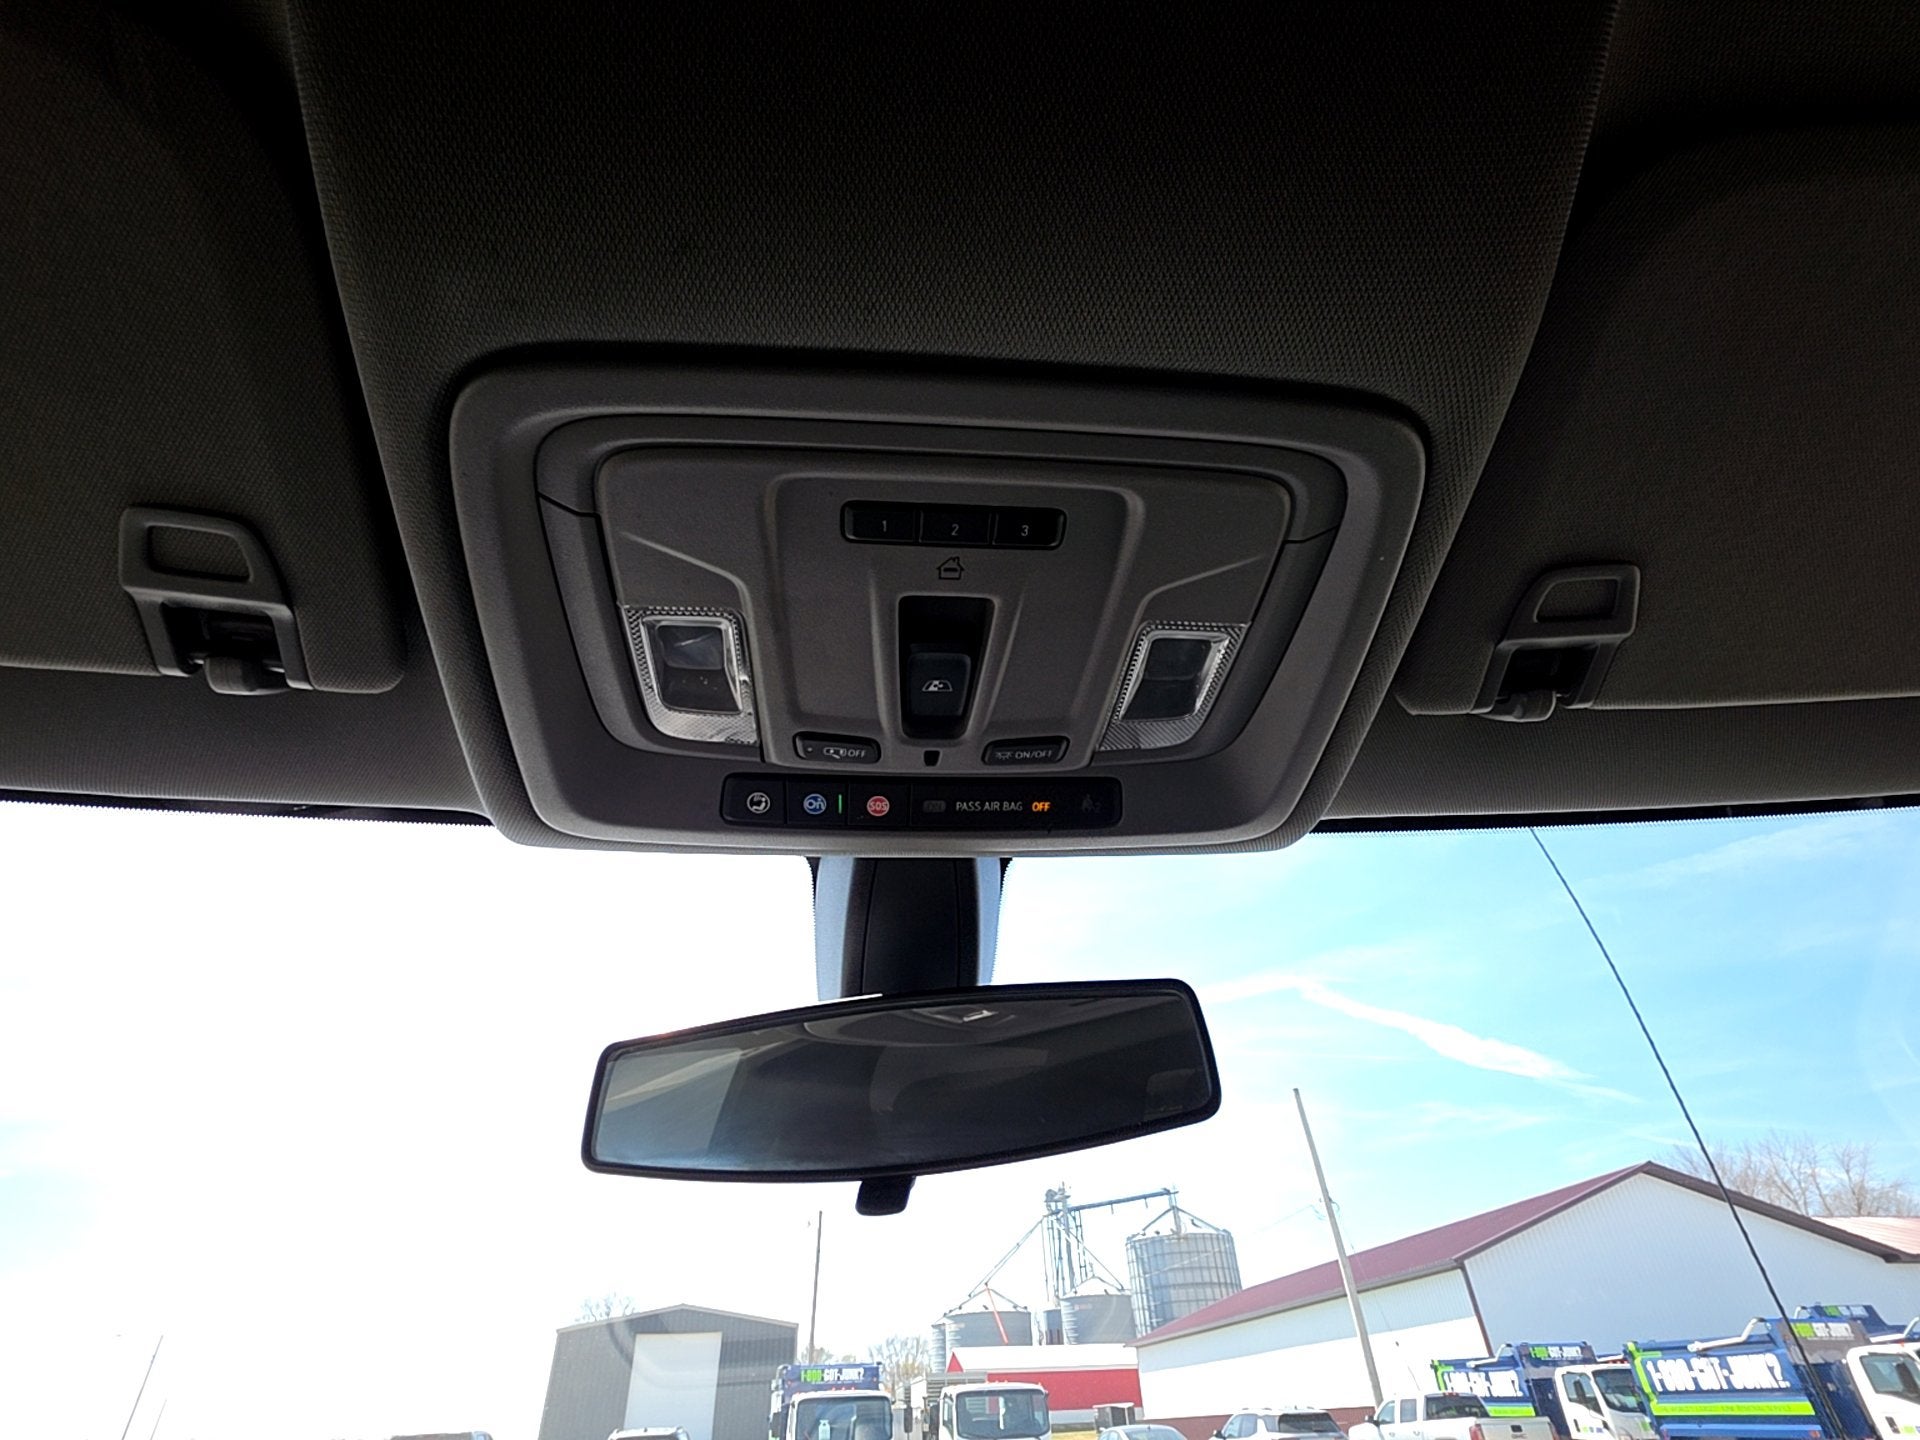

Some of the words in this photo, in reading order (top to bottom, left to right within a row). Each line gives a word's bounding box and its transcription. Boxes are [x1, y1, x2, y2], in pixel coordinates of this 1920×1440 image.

[881, 519, 888, 533] 1
[951, 523, 960, 536] 2
[1020, 524, 1030, 537] 3
[847, 749, 866, 758] OFF
[1015, 750, 1053, 760] ON/OFF
[869, 801, 887, 811] SOS
[955, 801, 982, 812] PASS
[983, 801, 1001, 812] AIR
[1002, 801, 1023, 812] BAG
[1031, 801, 1051, 812] OFF
